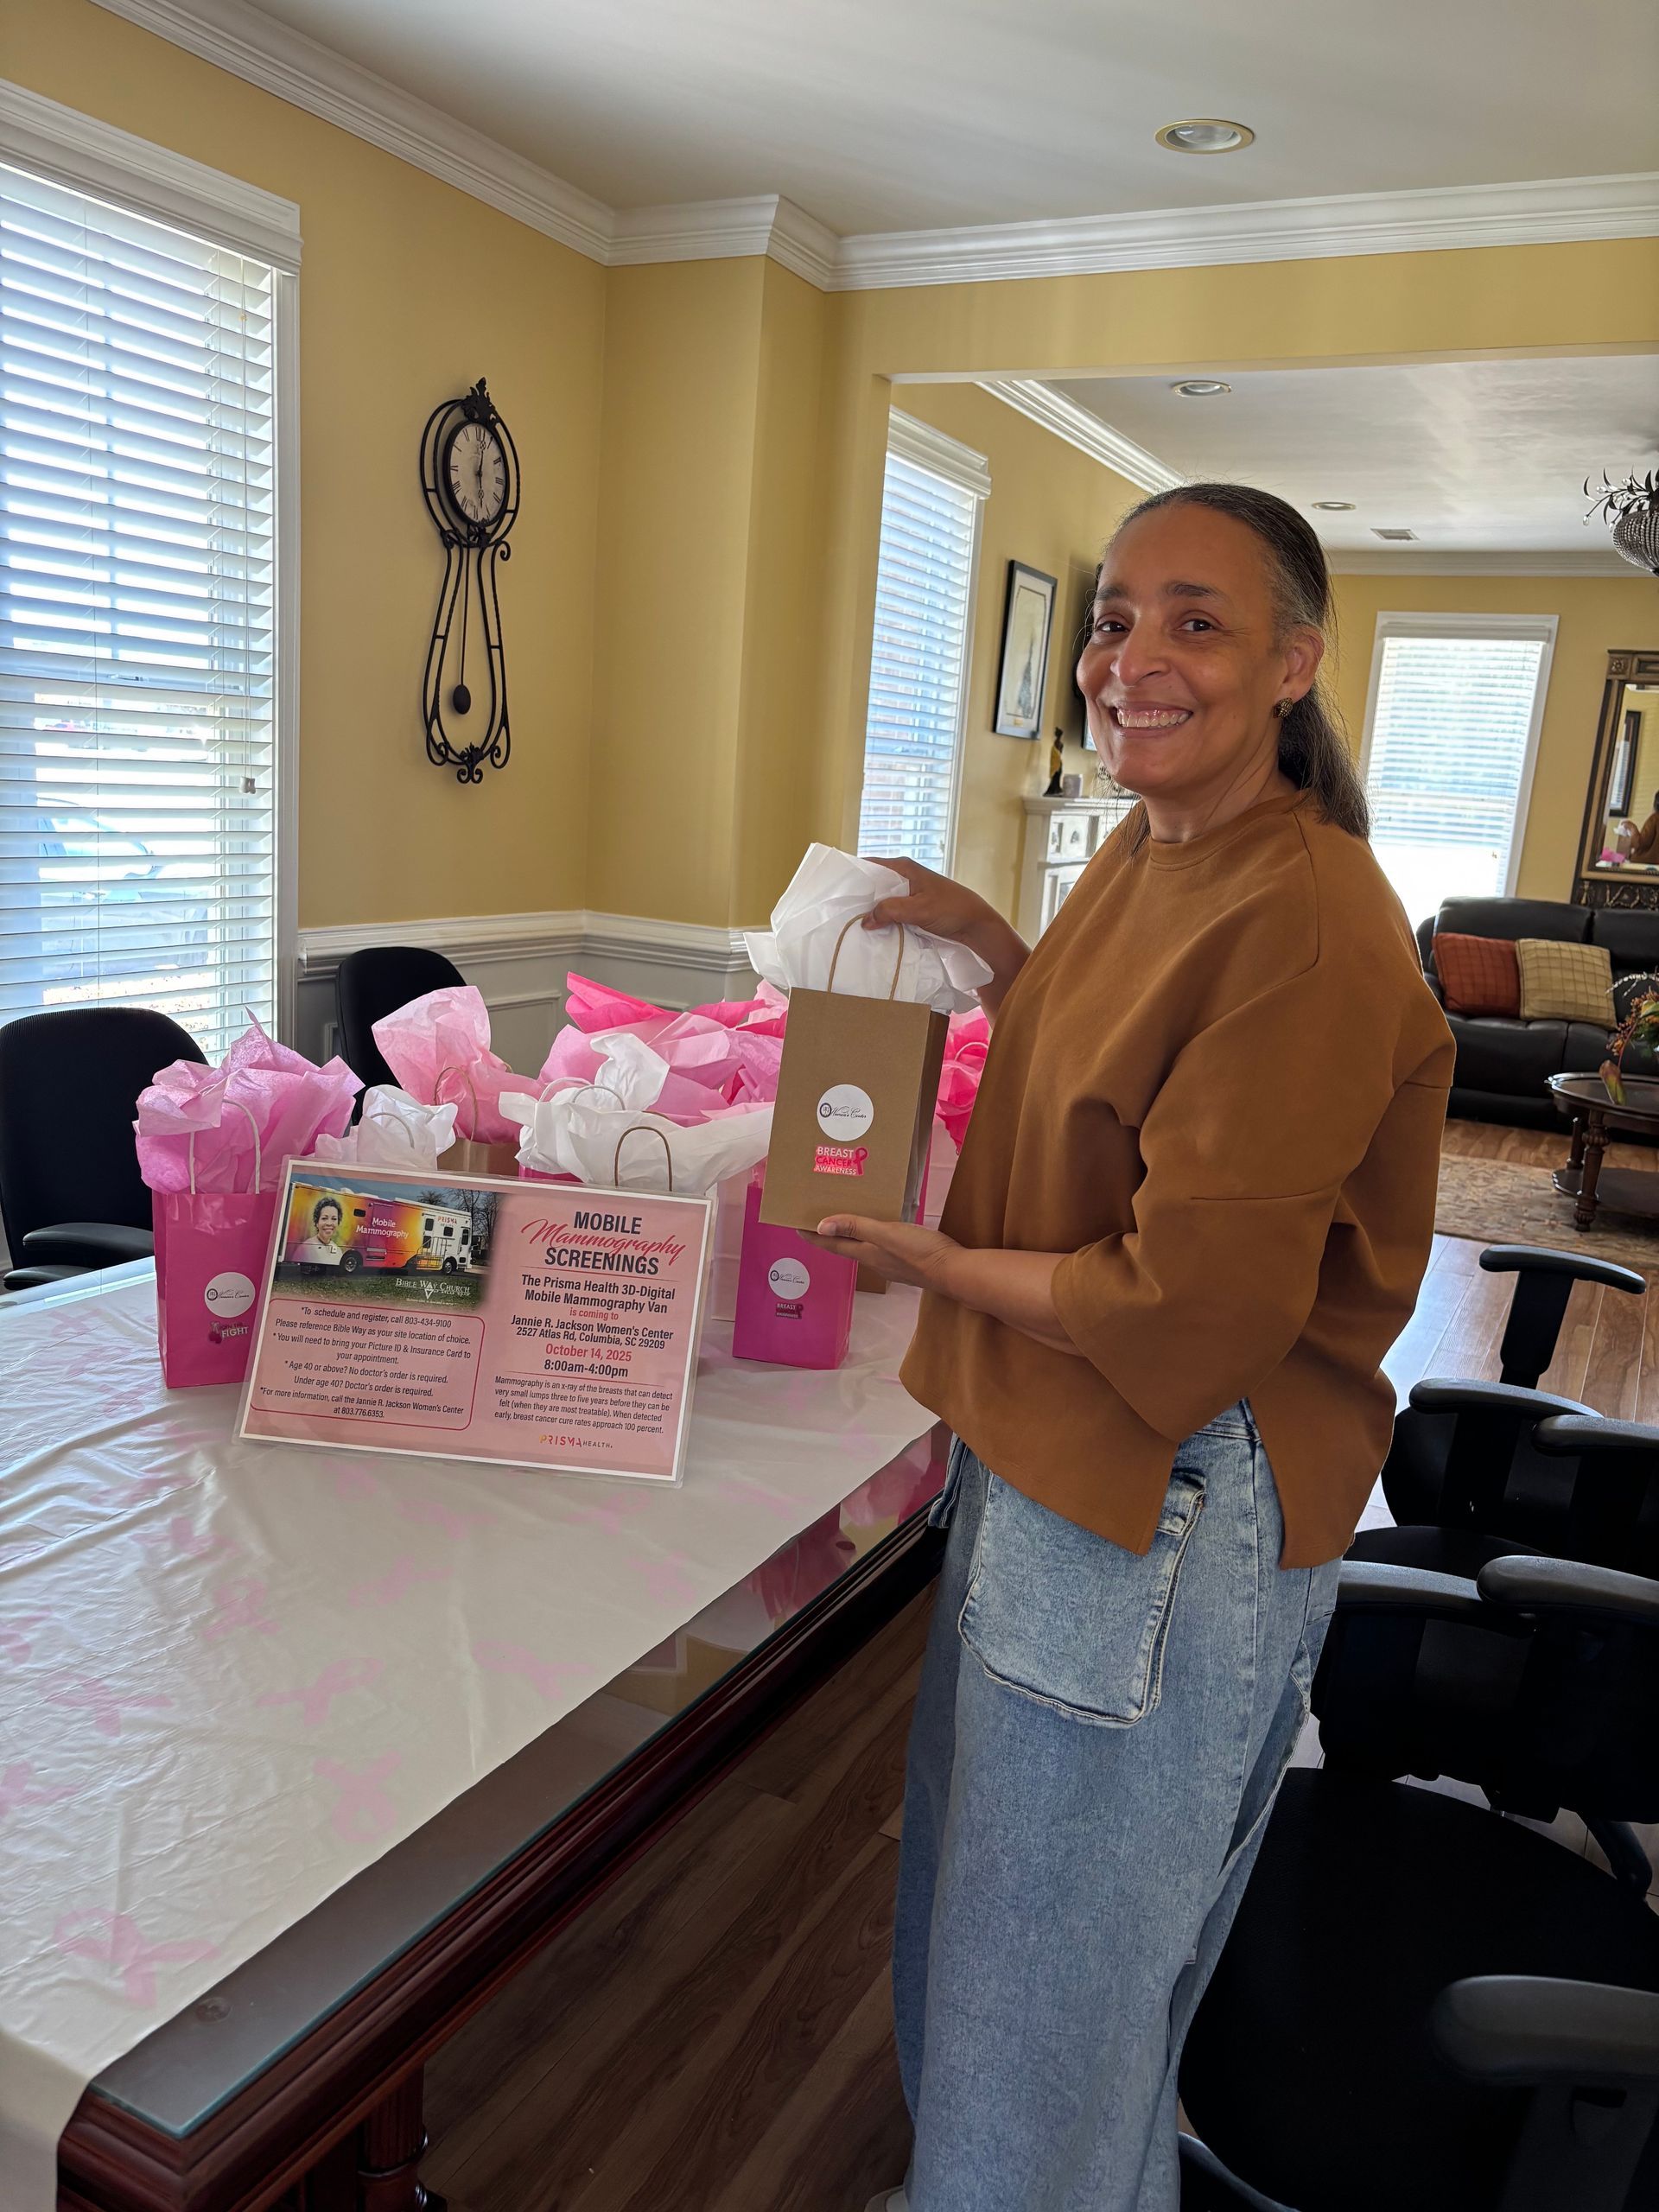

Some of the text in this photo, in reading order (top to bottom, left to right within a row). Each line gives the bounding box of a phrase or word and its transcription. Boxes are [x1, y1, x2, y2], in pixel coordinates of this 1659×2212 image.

[816, 1156, 852, 1166] CANCER
[817, 1147, 854, 1158] BREAST
[814, 1166, 856, 1175] AWARENESS
[356, 1225, 409, 1239] Mammography
[372, 1217, 396, 1227] Mobile
[574, 1211, 642, 1235] MOBILE
[521, 1219, 685, 1266] Mammography
[544, 1247, 659, 1275] SCREENINGS
[522, 1274, 676, 1300] The Prisma Health 3D-Digital
[525, 1289, 667, 1313] Mobile Mammography Van
[315, 1308, 346, 1319] schedule
[362, 1313, 389, 1323] register,
[404, 1317, 452, 1328] 803-434-9100
[569, 1307, 619, 1321] is coming to
[221, 1327, 249, 1338] FIGHT
[276, 1319, 298, 1328] Please
[299, 1321, 332, 1331] reference
[333, 1324, 350, 1333] Bible
[352, 1326, 367, 1336] Way
[394, 1330, 407, 1338] site
[409, 1331, 436, 1341] location
[446, 1335, 471, 1344] choice.
[512, 1315, 674, 1339] Jannie R. Jackson Women's Center
[332, 1338, 350, 1349] bring
[368, 1342, 393, 1351] Picture
[403, 1344, 409, 1353] &
[410, 1345, 445, 1357] Insurance
[447, 1349, 463, 1357] Card
[517, 1326, 665, 1350] 2527 Atlas Rd, Columbia, SC 29209
[336, 1352, 399, 1364] your appointment.
[546, 1344, 632, 1362] October 14, 2025
[289, 1361, 302, 1371] Age
[323, 1364, 348, 1374] above?
[360, 1368, 388, 1378] doctor's
[417, 1374, 448, 1383] required.
[544, 1359, 628, 1378] 8:00am-4:00pm
[295, 1376, 315, 1385] Under
[345, 1381, 373, 1391] Doctor's
[374, 1384, 393, 1393] order
[395, 1385, 401, 1394] is
[403, 1388, 433, 1396] required.
[495, 1376, 543, 1389] Mammography
[544, 1380, 550, 1389] is
[562, 1383, 578, 1392] x-ray
[599, 1385, 623, 1395] breasts
[652, 1391, 673, 1400] detect
[292, 1390, 329, 1402] information,
[356, 1397, 377, 1406] Jannie
[385, 1400, 411, 1409] Jackson
[413, 1402, 442, 1412] Women's
[442, 1405, 464, 1414] Center
[499, 1399, 510, 1408] felt
[512, 1400, 531, 1409] (when
[533, 1402, 548, 1413] they
[579, 1408, 611, 1418] treatable).
[613, 1410, 632, 1419] When
[633, 1412, 662, 1421] detected
[530, 1390, 550, 1401] lumps
[551, 1393, 568, 1402] three
[577, 1395, 589, 1403] five
[610, 1398, 631, 1408] before
[632, 1400, 646, 1410] they
[341, 1407, 385, 1418] 803.776.6353.
[494, 1411, 512, 1421] early,
[513, 1412, 534, 1421] breast
[592, 1421, 623, 1430] approach
[539, 1434, 582, 1447] PRISMA
